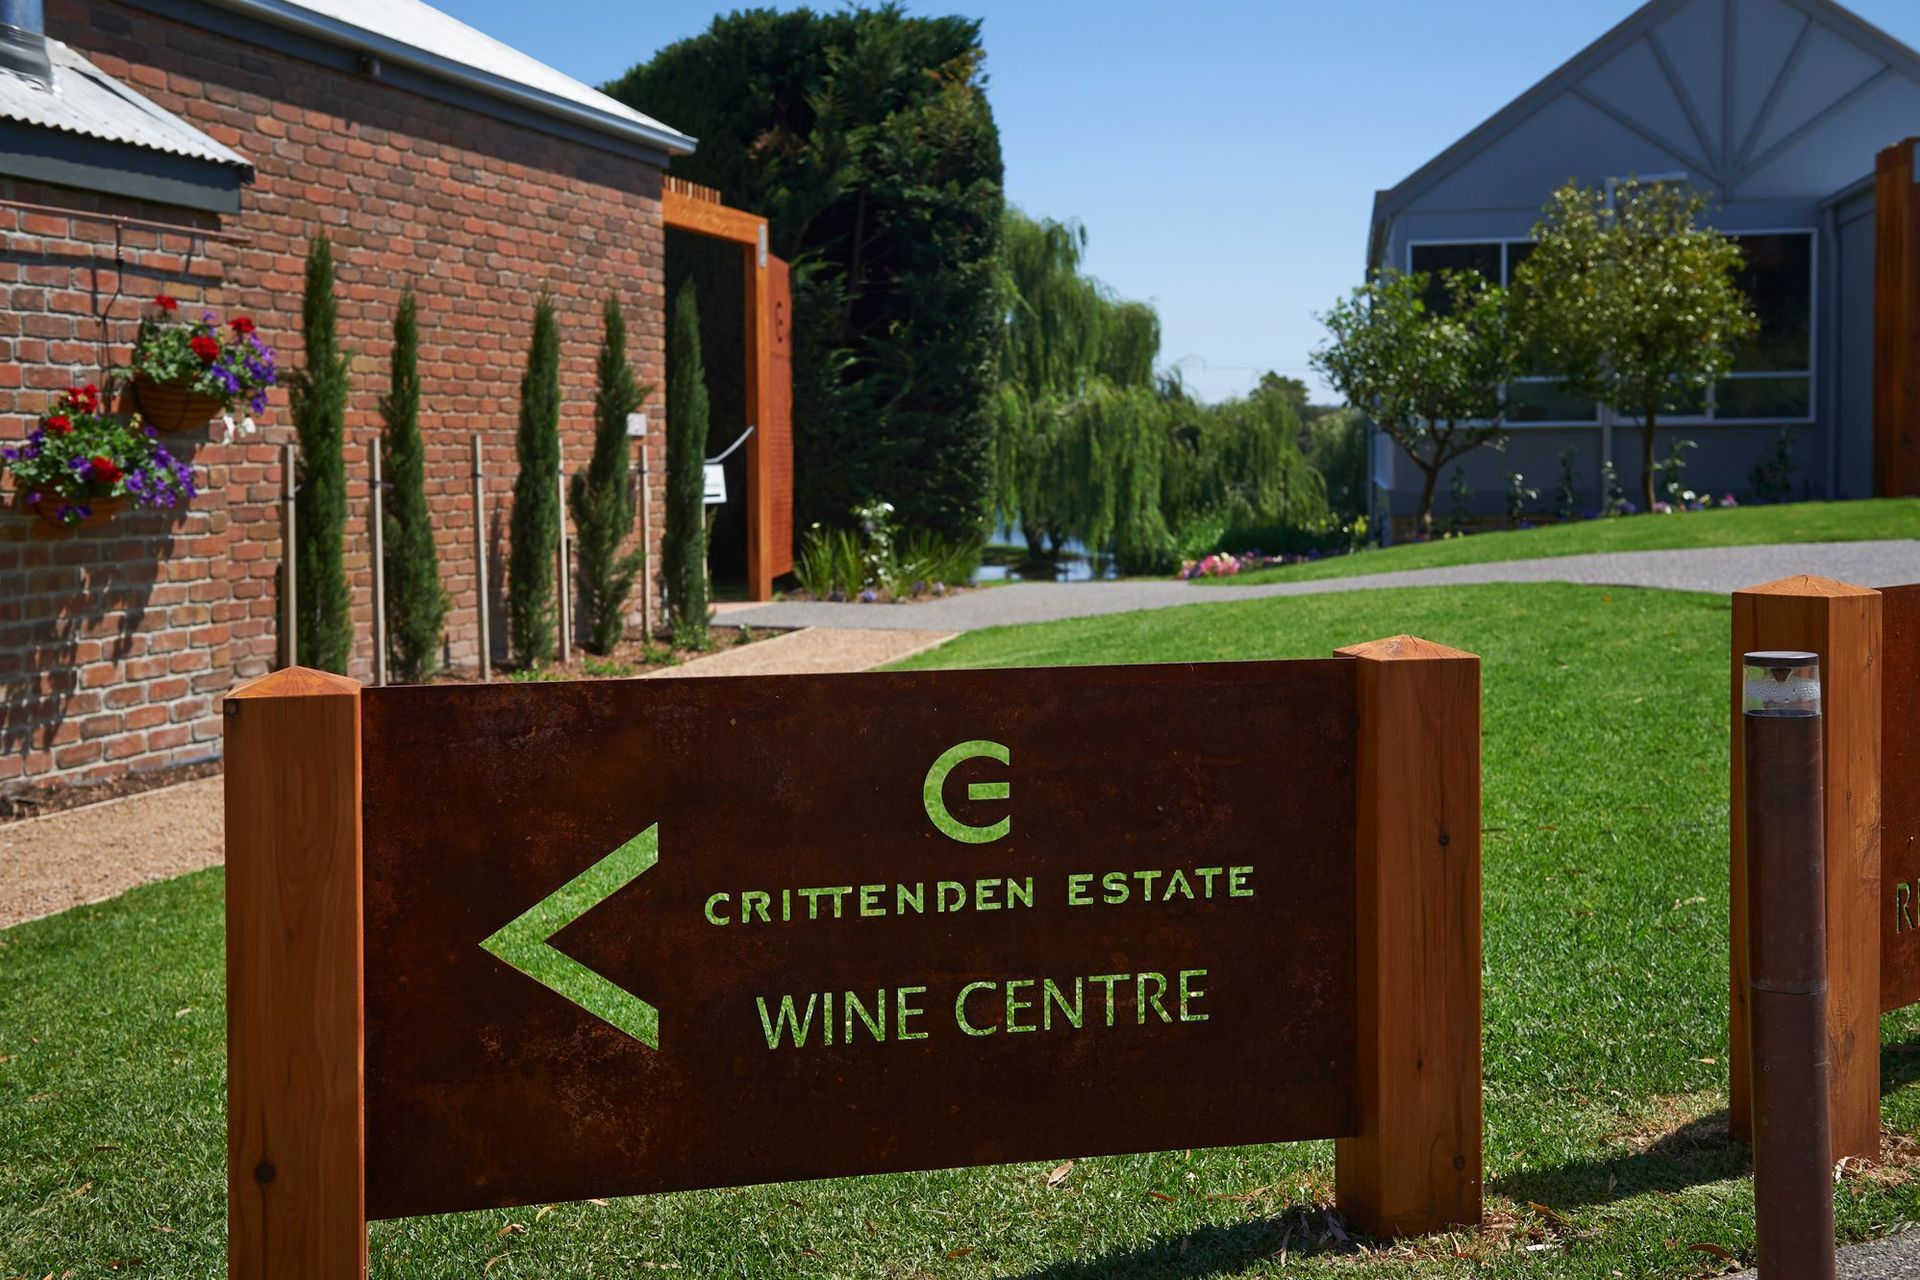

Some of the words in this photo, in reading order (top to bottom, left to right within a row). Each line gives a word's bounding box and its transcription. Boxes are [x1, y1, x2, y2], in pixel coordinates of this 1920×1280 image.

[704, 877, 1034, 926] CRITTENDEN
[1068, 866, 1255, 906] ESTATE
[1896, 878, 1920, 934] R
[755, 986, 929, 1050] WINE
[955, 969, 1210, 1038] CENTRE
